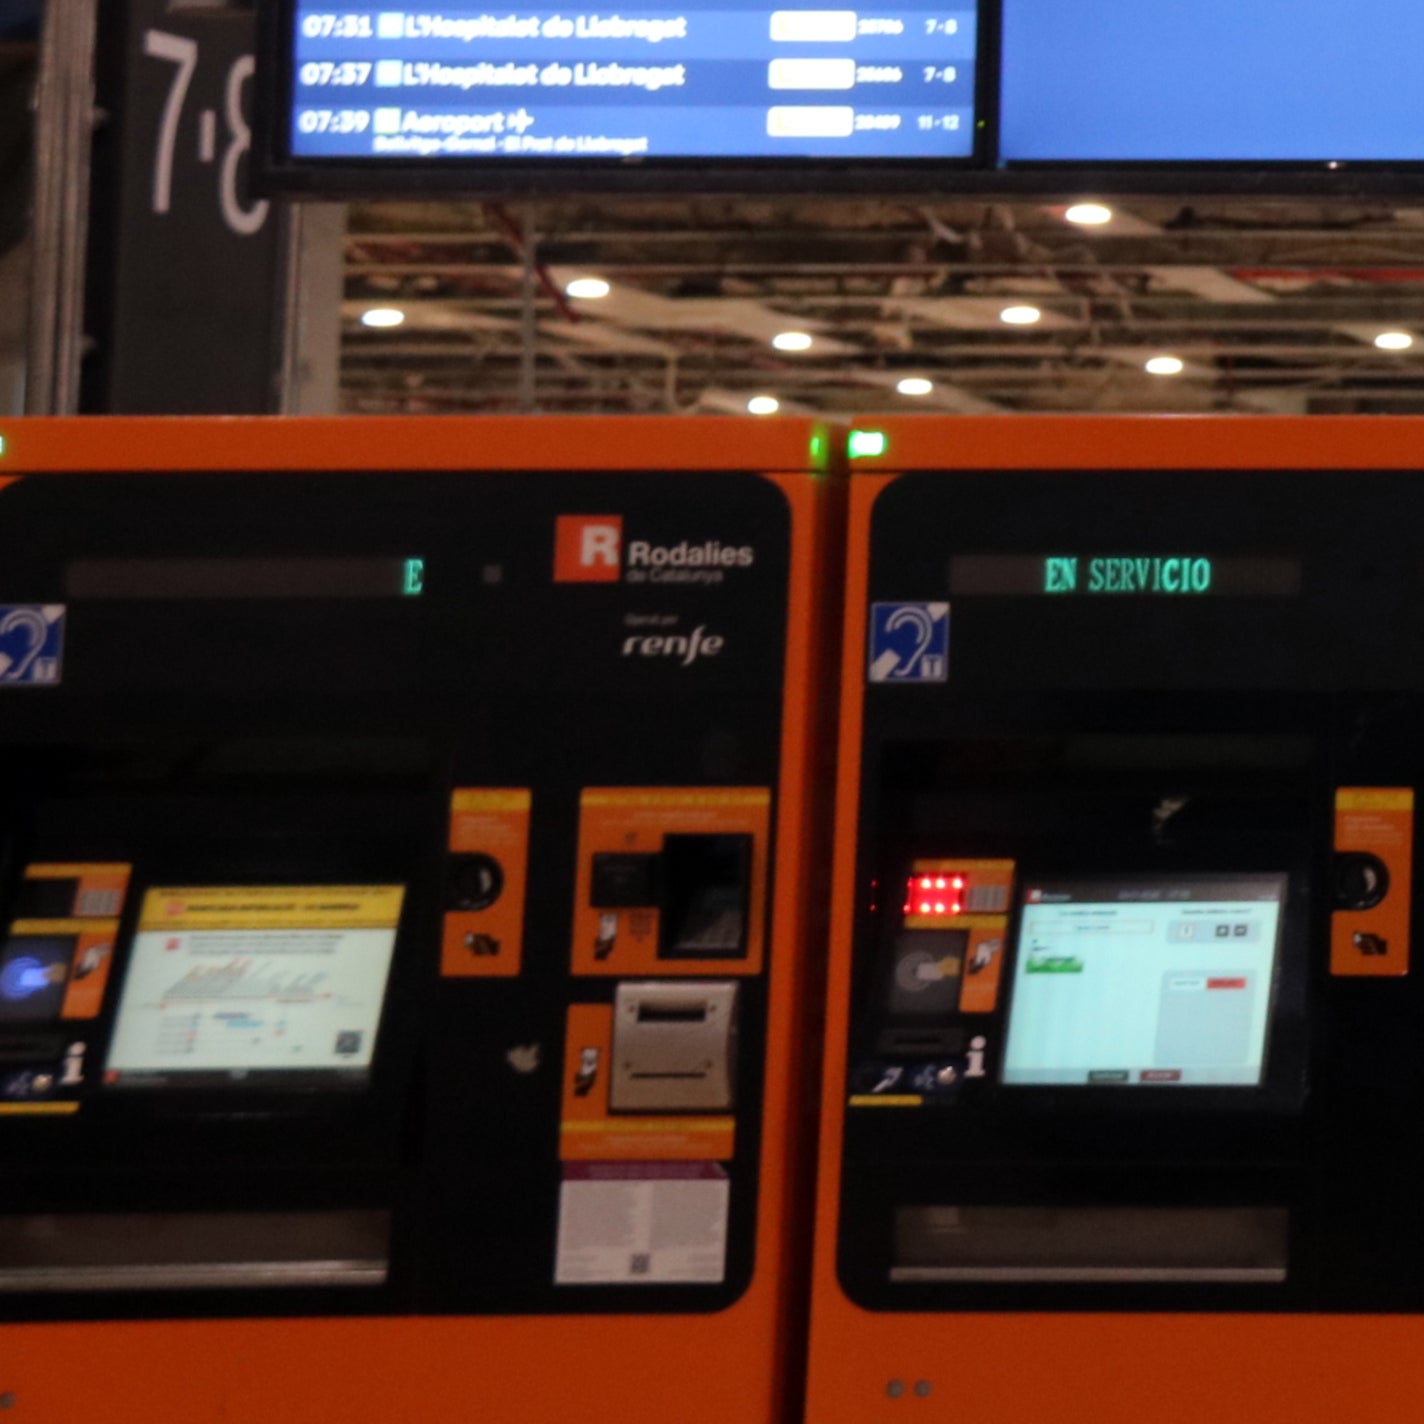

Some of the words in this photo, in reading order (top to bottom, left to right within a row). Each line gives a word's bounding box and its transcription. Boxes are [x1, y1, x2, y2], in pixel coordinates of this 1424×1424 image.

[580, 526, 619, 565] R
[628, 542, 753, 566] Rodalies
[1045, 557, 1077, 591] EN
[1088, 557, 1211, 592] SERVICIO
[622, 625, 725, 666] renfe
